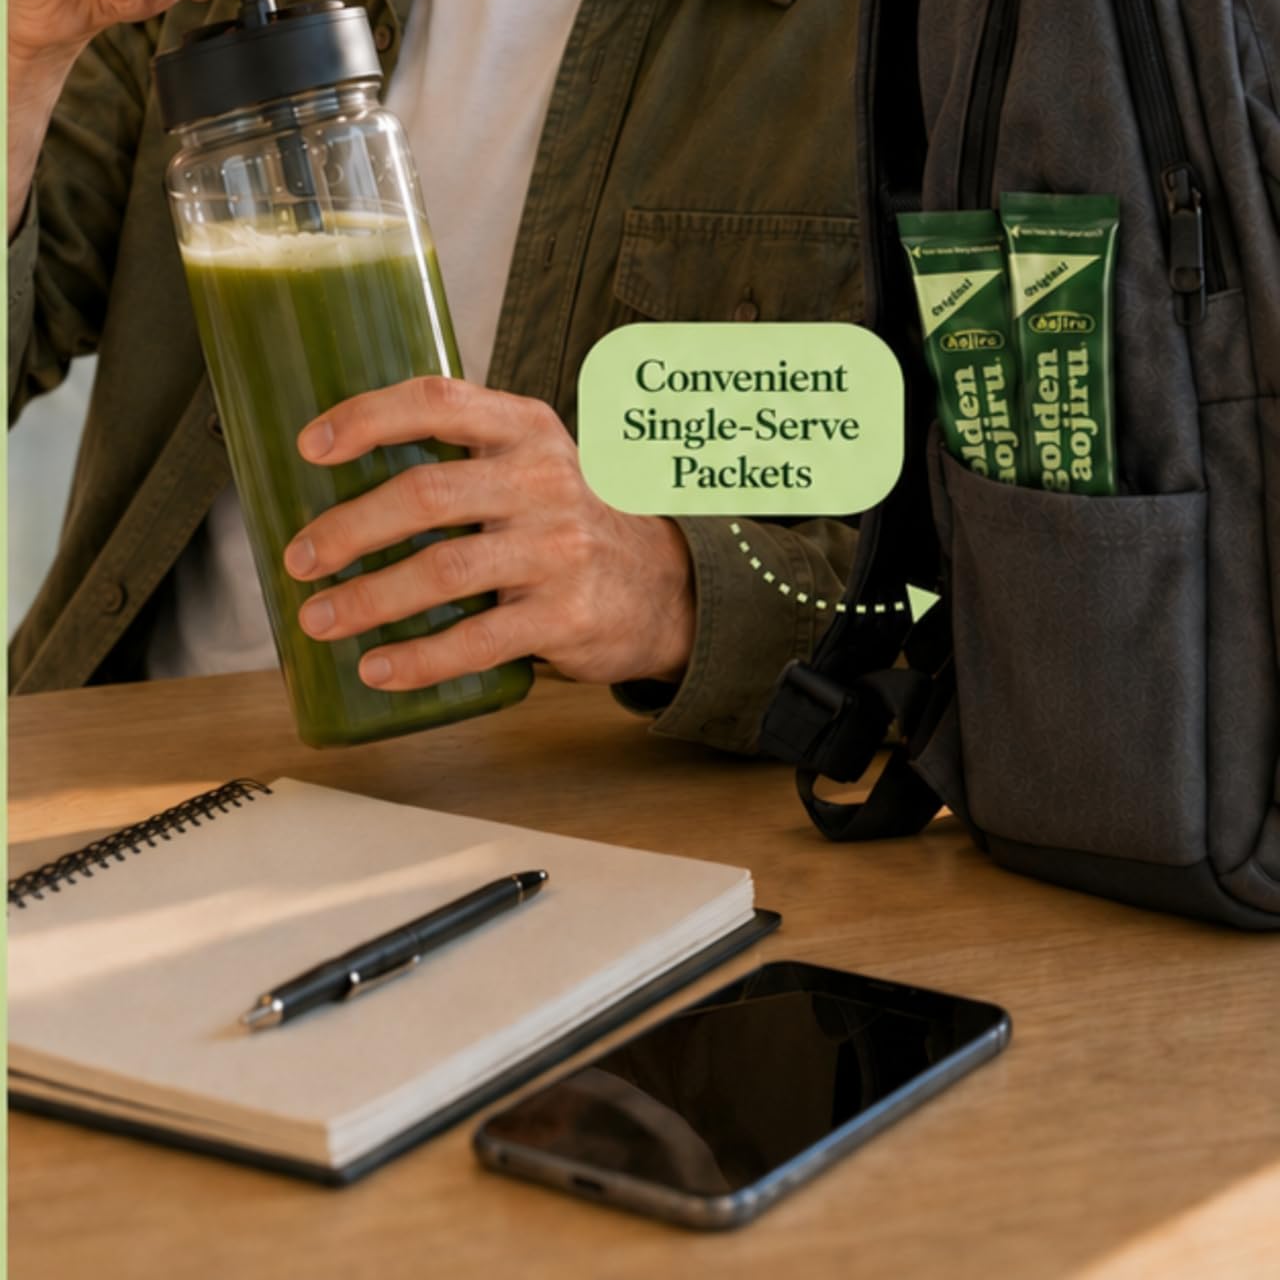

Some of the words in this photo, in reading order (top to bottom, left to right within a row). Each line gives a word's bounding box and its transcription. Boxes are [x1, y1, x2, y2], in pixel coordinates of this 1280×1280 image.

[1024, 261, 1069, 297] Original
[955, 365, 988, 477] olden
[1062, 348, 1098, 481] aojiru
